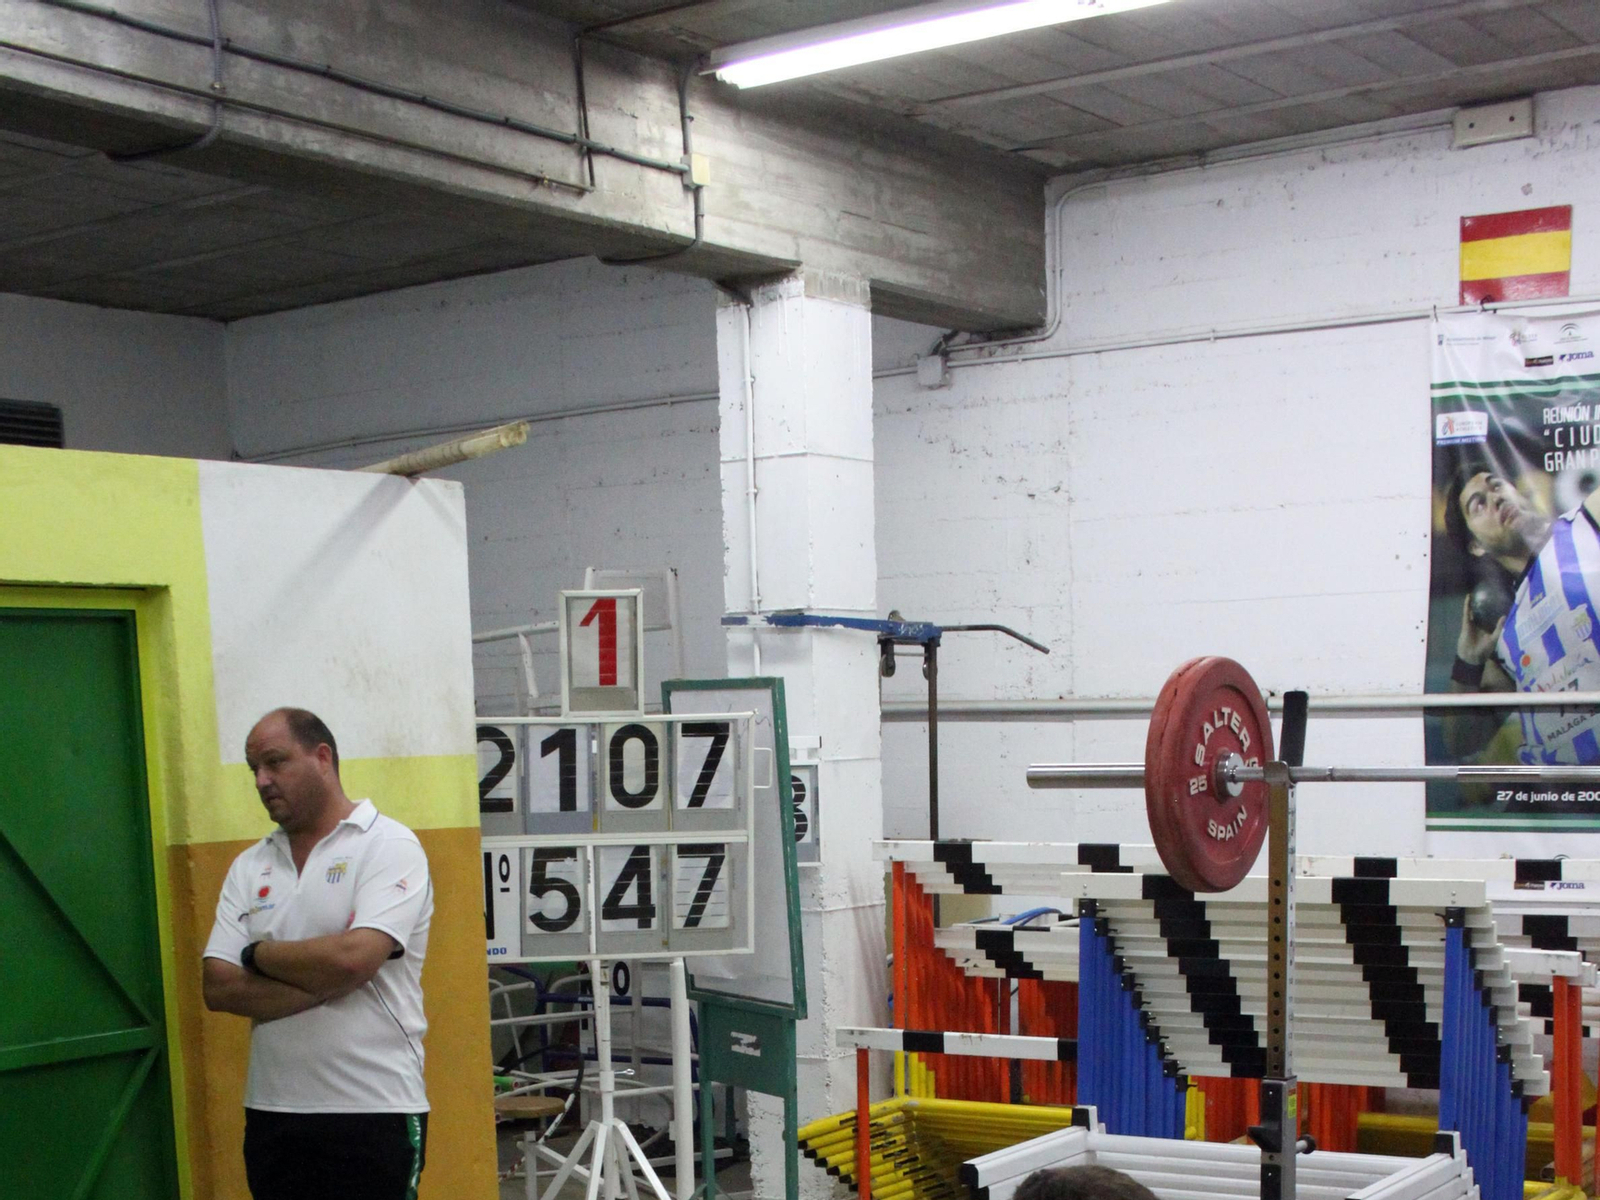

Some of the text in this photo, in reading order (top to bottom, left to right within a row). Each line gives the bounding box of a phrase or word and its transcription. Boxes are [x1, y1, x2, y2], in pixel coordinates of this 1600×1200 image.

[1543, 402, 1590, 425] REUNIÓN
[1544, 449, 1586, 472] GRAN
[579, 598, 617, 686] 1
[1195, 707, 1251, 766] SALTER
[1547, 715, 1587, 742] MALAGA
[1190, 775, 1207, 795] 25
[1496, 790, 1513, 801] 27
[1515, 791, 1528, 801] de
[1530, 791, 1559, 803] junio
[1561, 791, 1575, 801] de
[1207, 805, 1248, 841] SPAIN
[529, 843, 726, 933] 547
